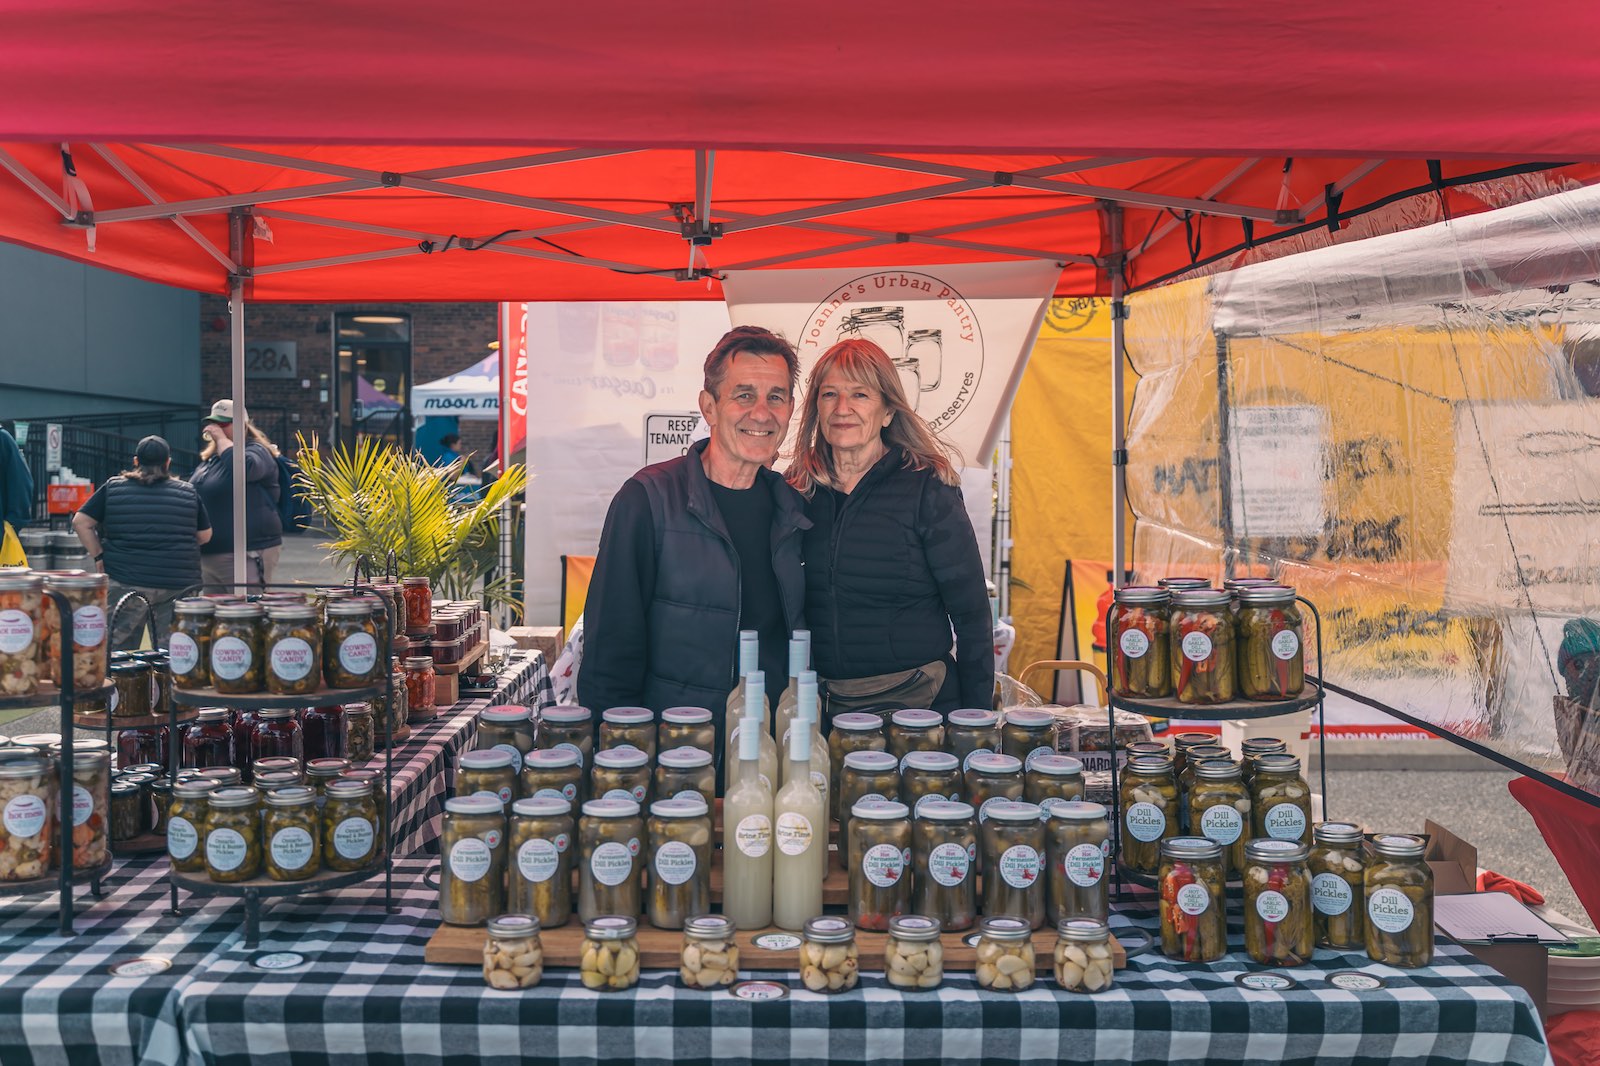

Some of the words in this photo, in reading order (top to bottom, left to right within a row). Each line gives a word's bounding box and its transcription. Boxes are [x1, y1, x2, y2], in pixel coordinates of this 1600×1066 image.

[805, 284, 866, 347] Joanne's
[874, 274, 932, 292] Urban
[937, 287, 974, 344] Pantry
[246, 347, 293, 371] 28A
[424, 398, 478, 409] moon
[482, 398, 499, 408] m
[928, 371, 974, 433] preserves
[650, 433, 691, 445] TENANT
[681, 447, 689, 457] O
[344, 644, 374, 652] COWBOY
[1137, 808, 1152, 816] Dill
[1214, 812, 1229, 820] Dill
[1278, 810, 1293, 818] Dill
[1130, 816, 1161, 826] Pickles
[1206, 820, 1238, 828] Pickles
[1270, 818, 1302, 827] Pickles
[1322, 880, 1338, 889] Dill
[1314, 888, 1348, 899] Pickles
[1382, 896, 1398, 905] Dill
[1373, 904, 1409, 915] Pickles
